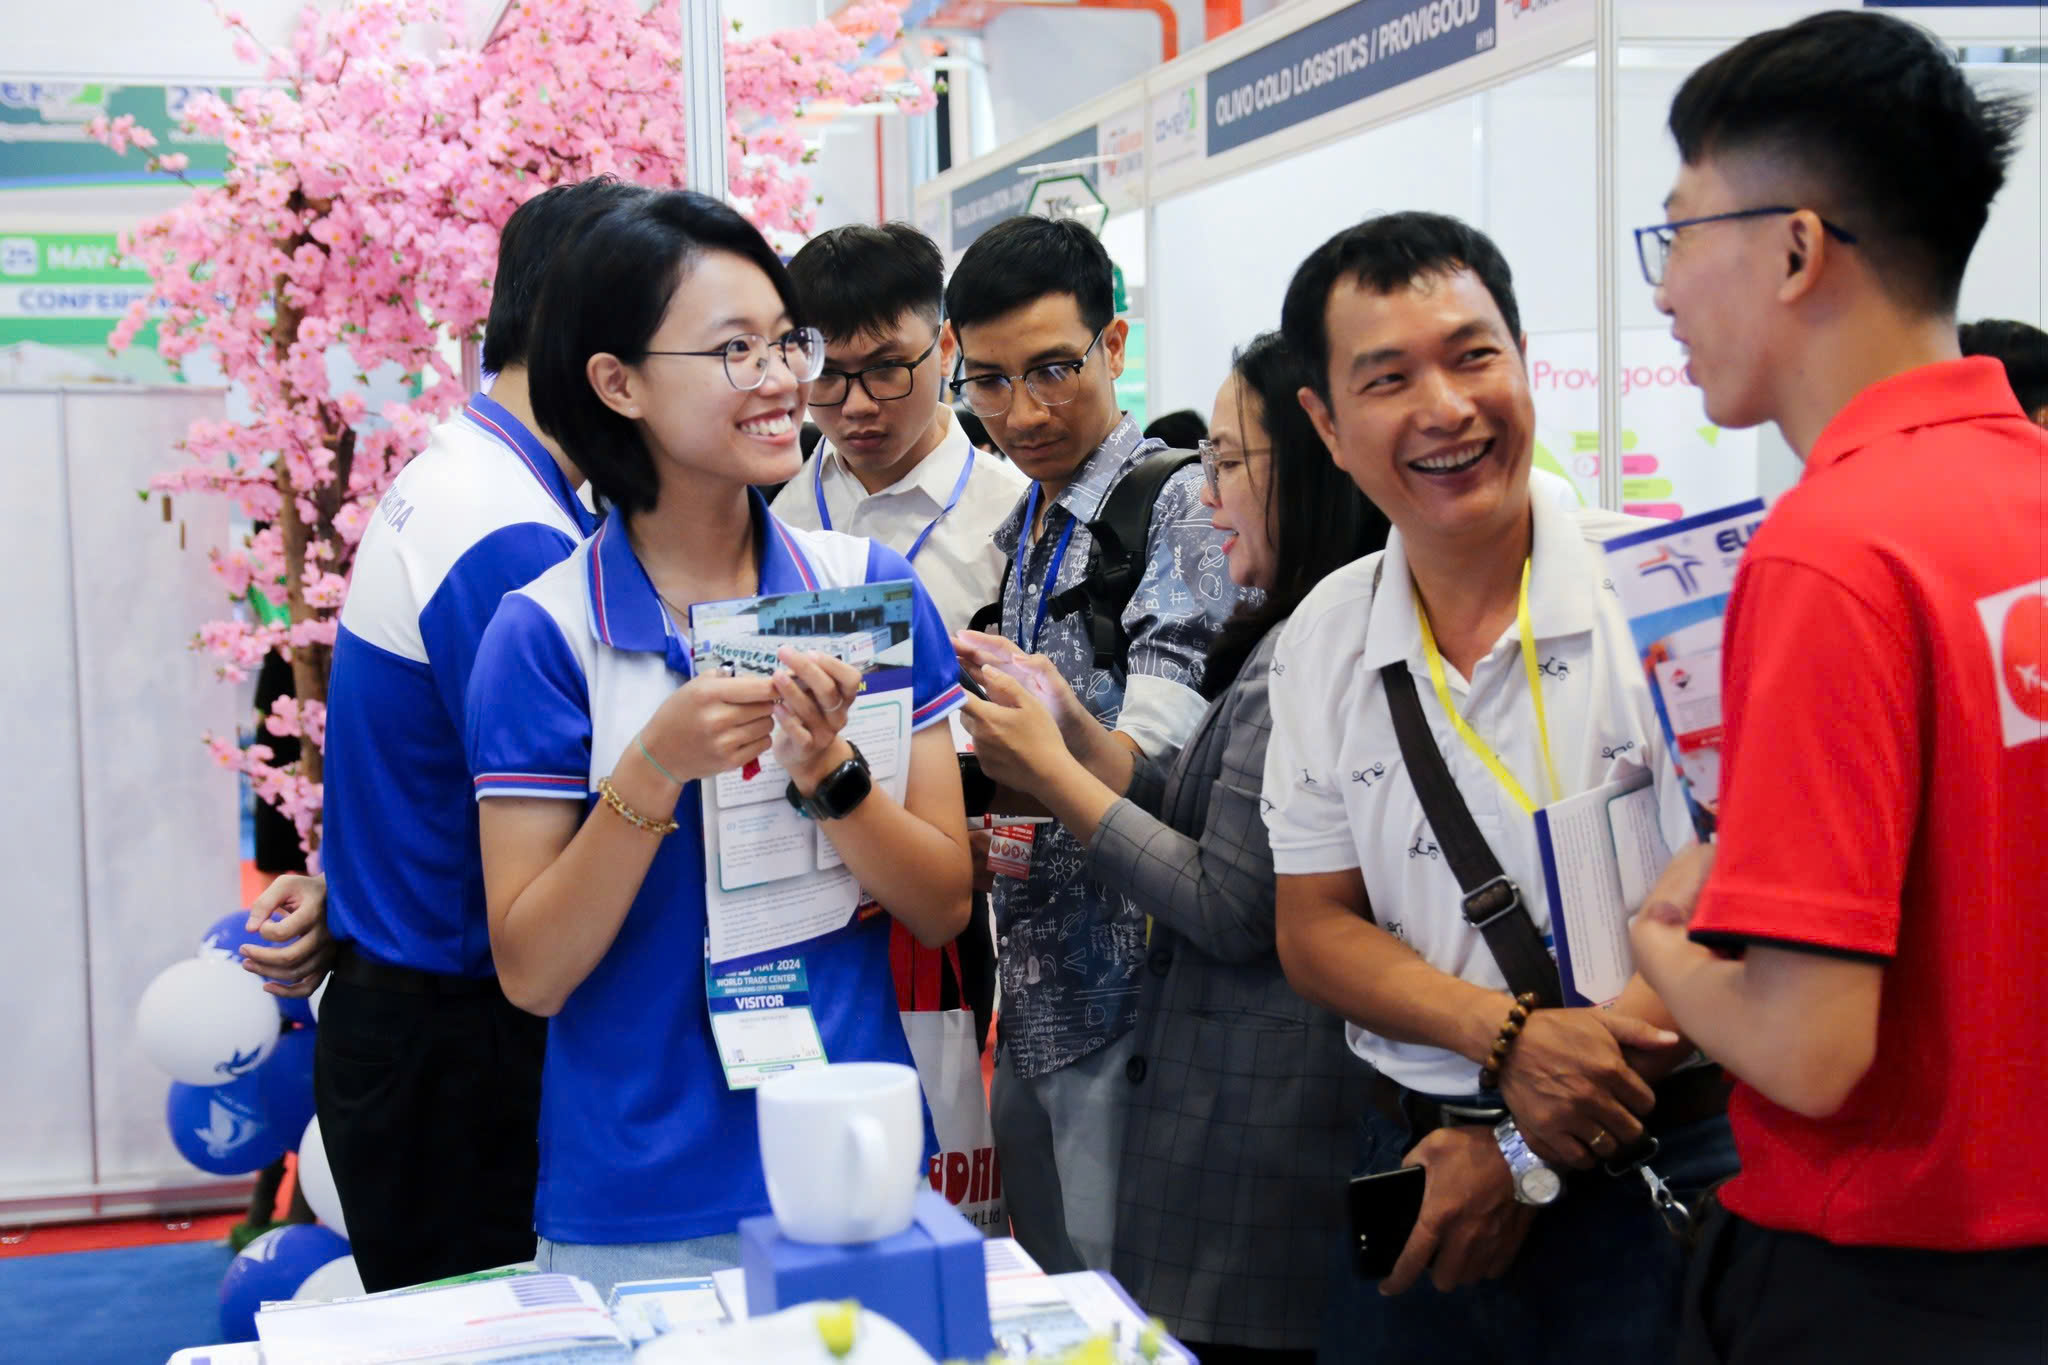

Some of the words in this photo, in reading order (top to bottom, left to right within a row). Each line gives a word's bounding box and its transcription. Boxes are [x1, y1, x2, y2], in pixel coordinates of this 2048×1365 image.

[1215, 84, 1254, 126] OLIVO
[1254, 67, 1291, 110] COLD
[1294, 35, 1368, 94] LOGISTICS
[1370, 29, 1378, 64] /
[1379, 0, 1480, 59] PROVIGOOD
[1170, 544, 1184, 579] Space
[777, 959, 801, 971] 2024
[716, 977, 744, 988] WORLD
[745, 975, 768, 986] TRADE
[769, 973, 797, 984] CENTER
[735, 994, 784, 1009] VISITOR
[981, 1207, 1002, 1225] Ltd
